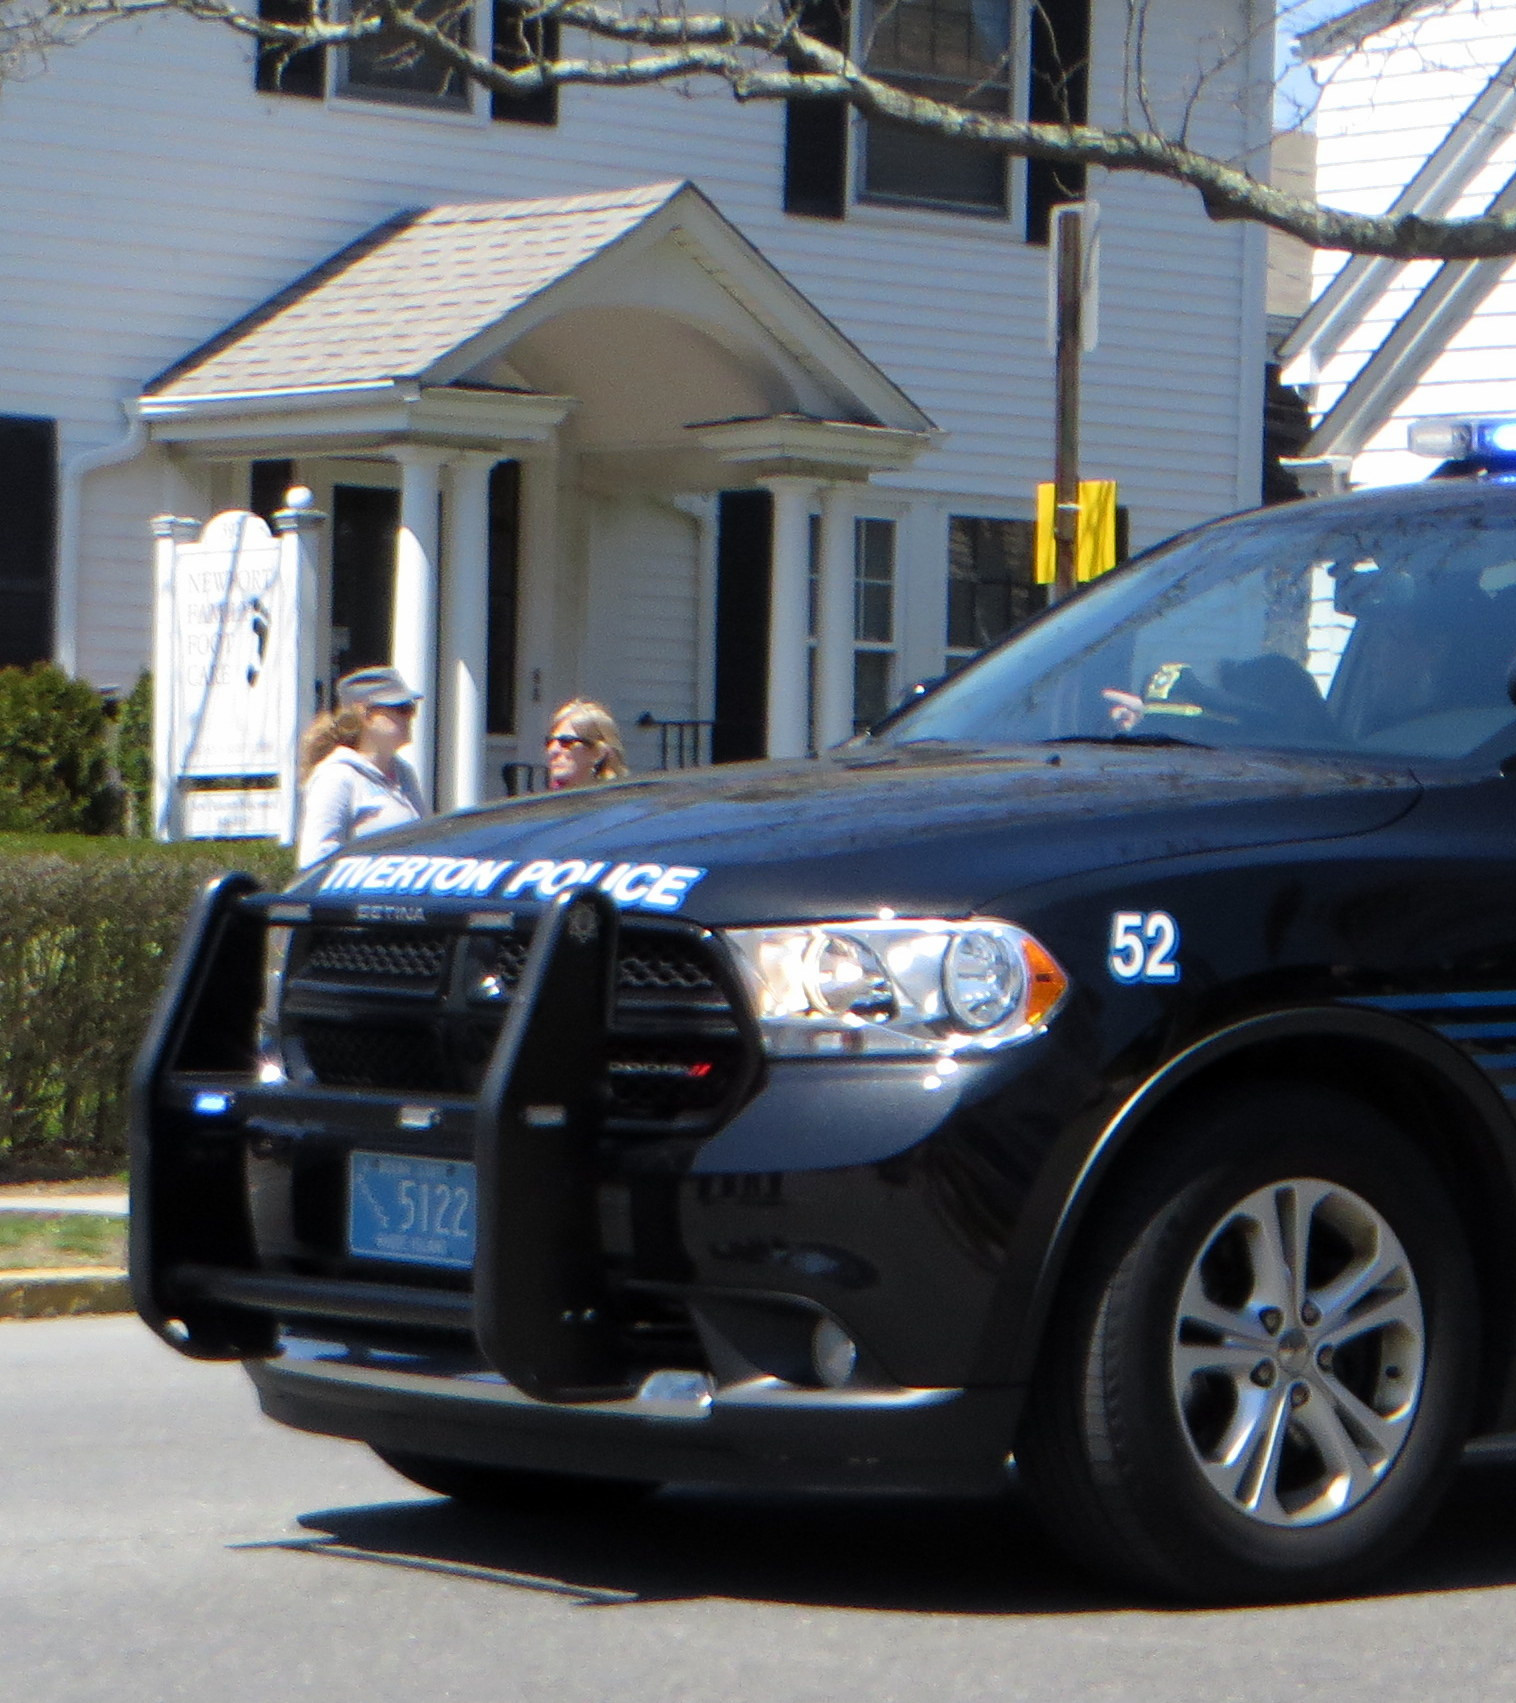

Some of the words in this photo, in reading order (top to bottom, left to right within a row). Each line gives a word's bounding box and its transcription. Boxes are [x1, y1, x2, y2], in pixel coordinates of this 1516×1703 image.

[320, 854, 514, 896] TIVERTON
[1110, 912, 1178, 979] 52
[398, 1179, 470, 1237] 5122
